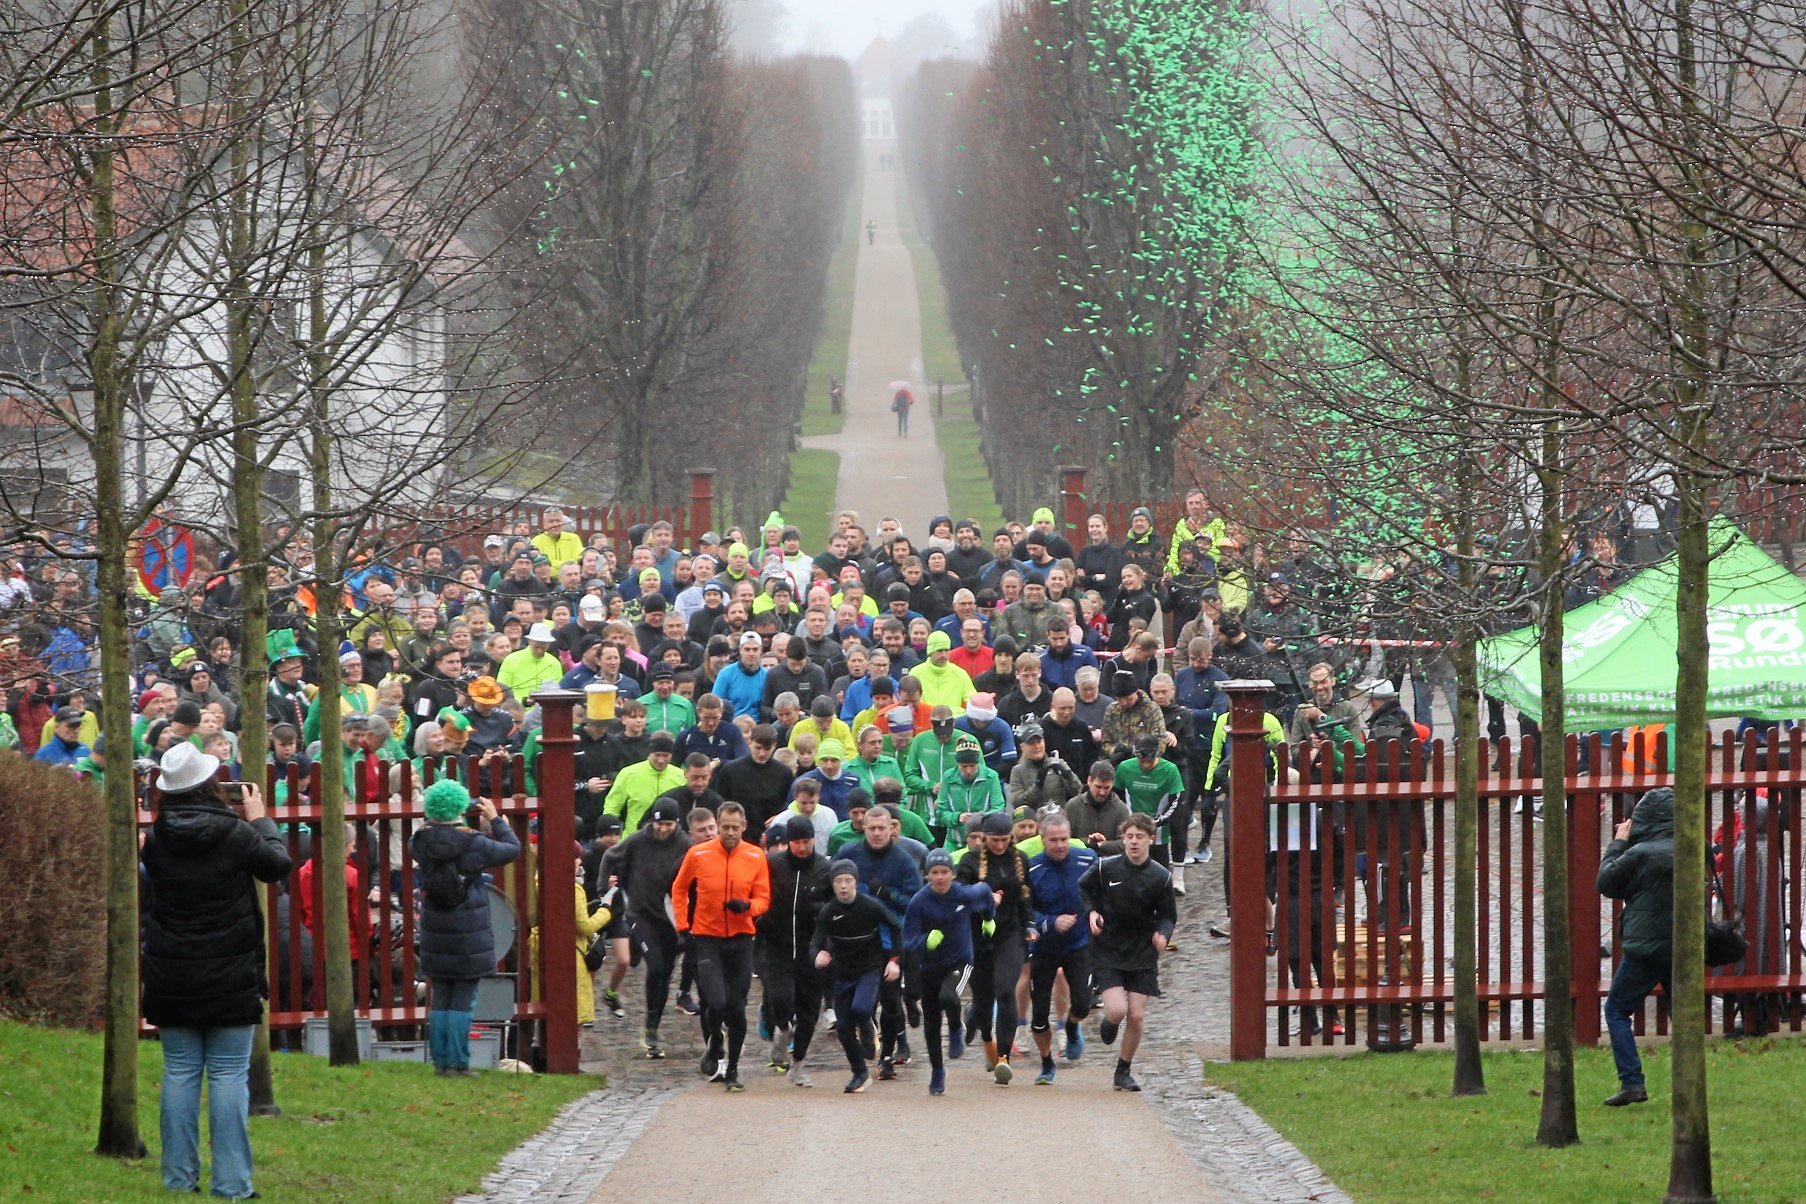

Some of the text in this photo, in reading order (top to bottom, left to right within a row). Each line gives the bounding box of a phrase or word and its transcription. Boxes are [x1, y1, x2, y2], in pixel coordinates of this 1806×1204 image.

[1707, 618, 1804, 653] SØ
[1713, 694, 1806, 708] ATLETIK K
[1567, 704, 1640, 717] ATLETIK
